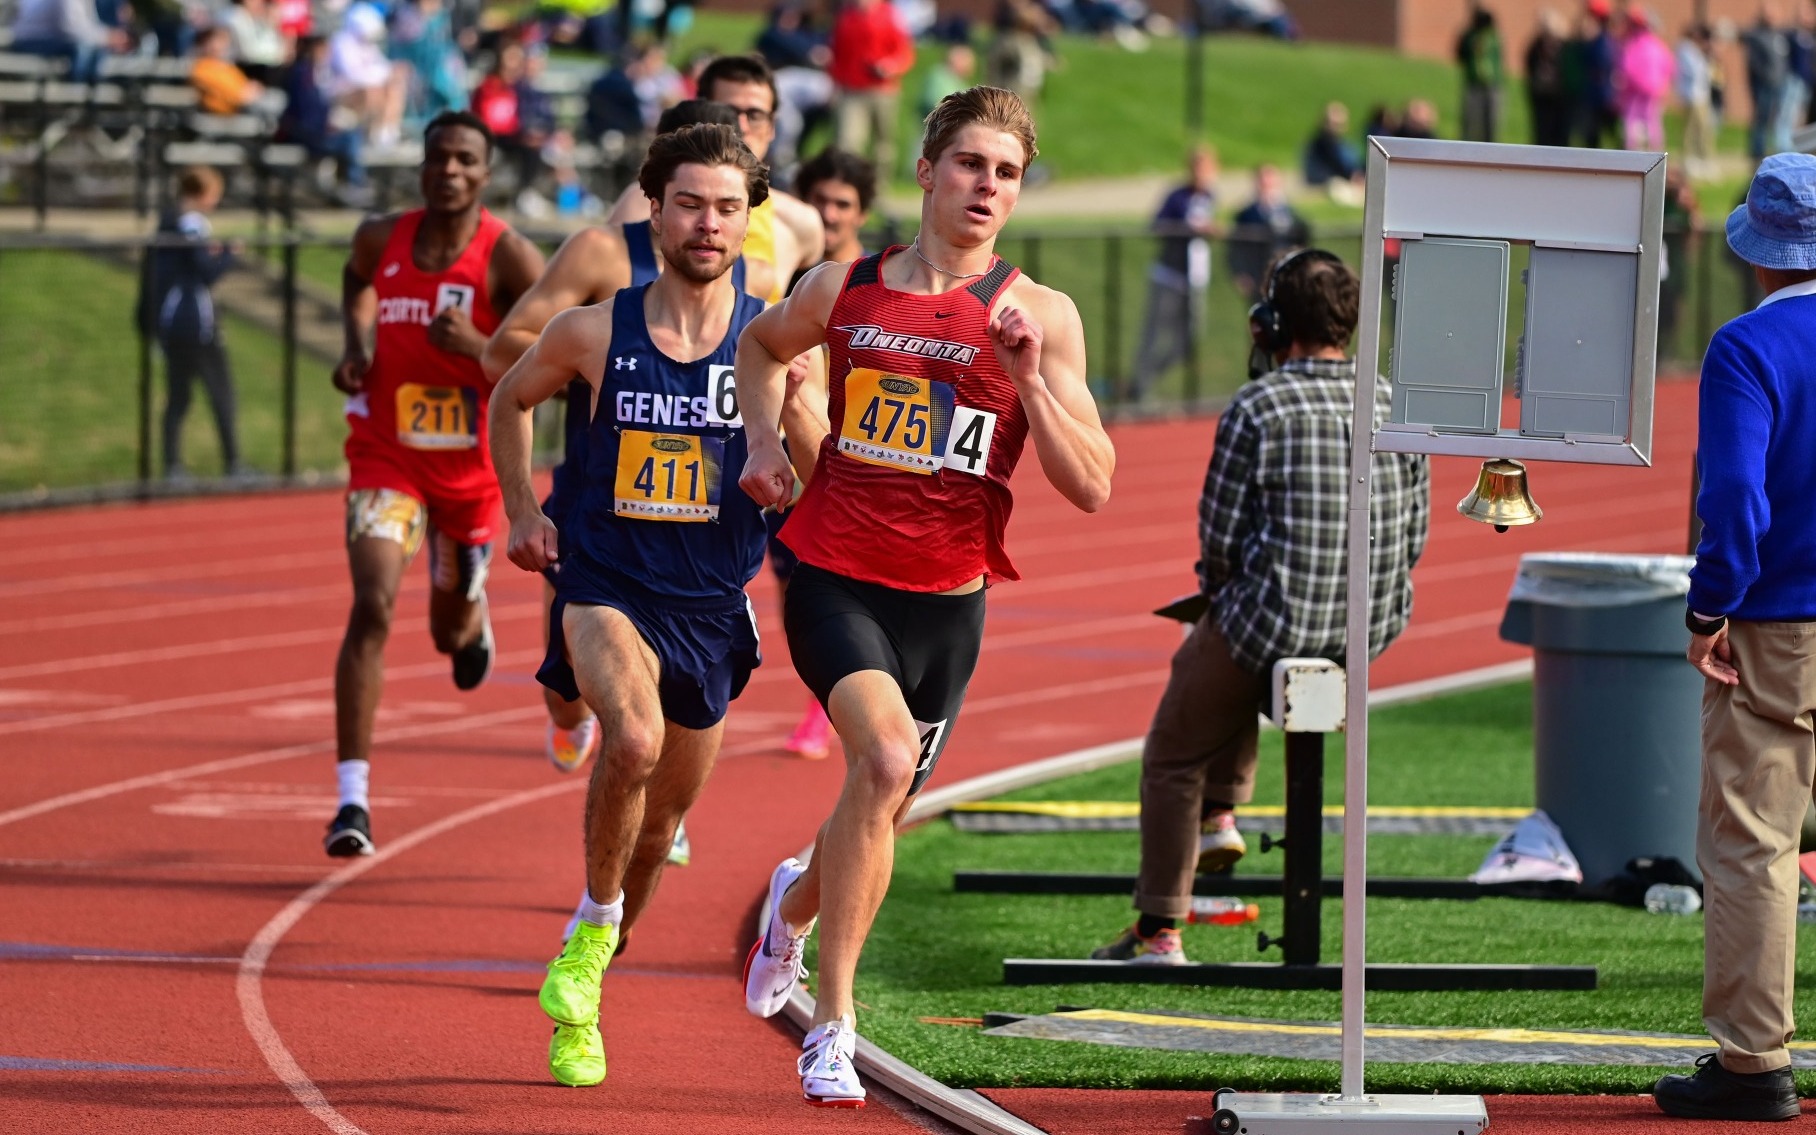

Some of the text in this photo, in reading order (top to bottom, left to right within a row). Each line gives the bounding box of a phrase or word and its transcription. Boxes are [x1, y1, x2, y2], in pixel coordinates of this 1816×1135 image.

[379, 297, 433, 326] CORTL
[832, 325, 980, 366] ONEONTA
[411, 401, 461, 432] 211
[616, 391, 742, 428] GENES
[716, 369, 740, 421] 6
[858, 396, 929, 449] 475
[953, 414, 986, 470] 4
[633, 456, 699, 501] 411
[917, 726, 940, 769] 4
